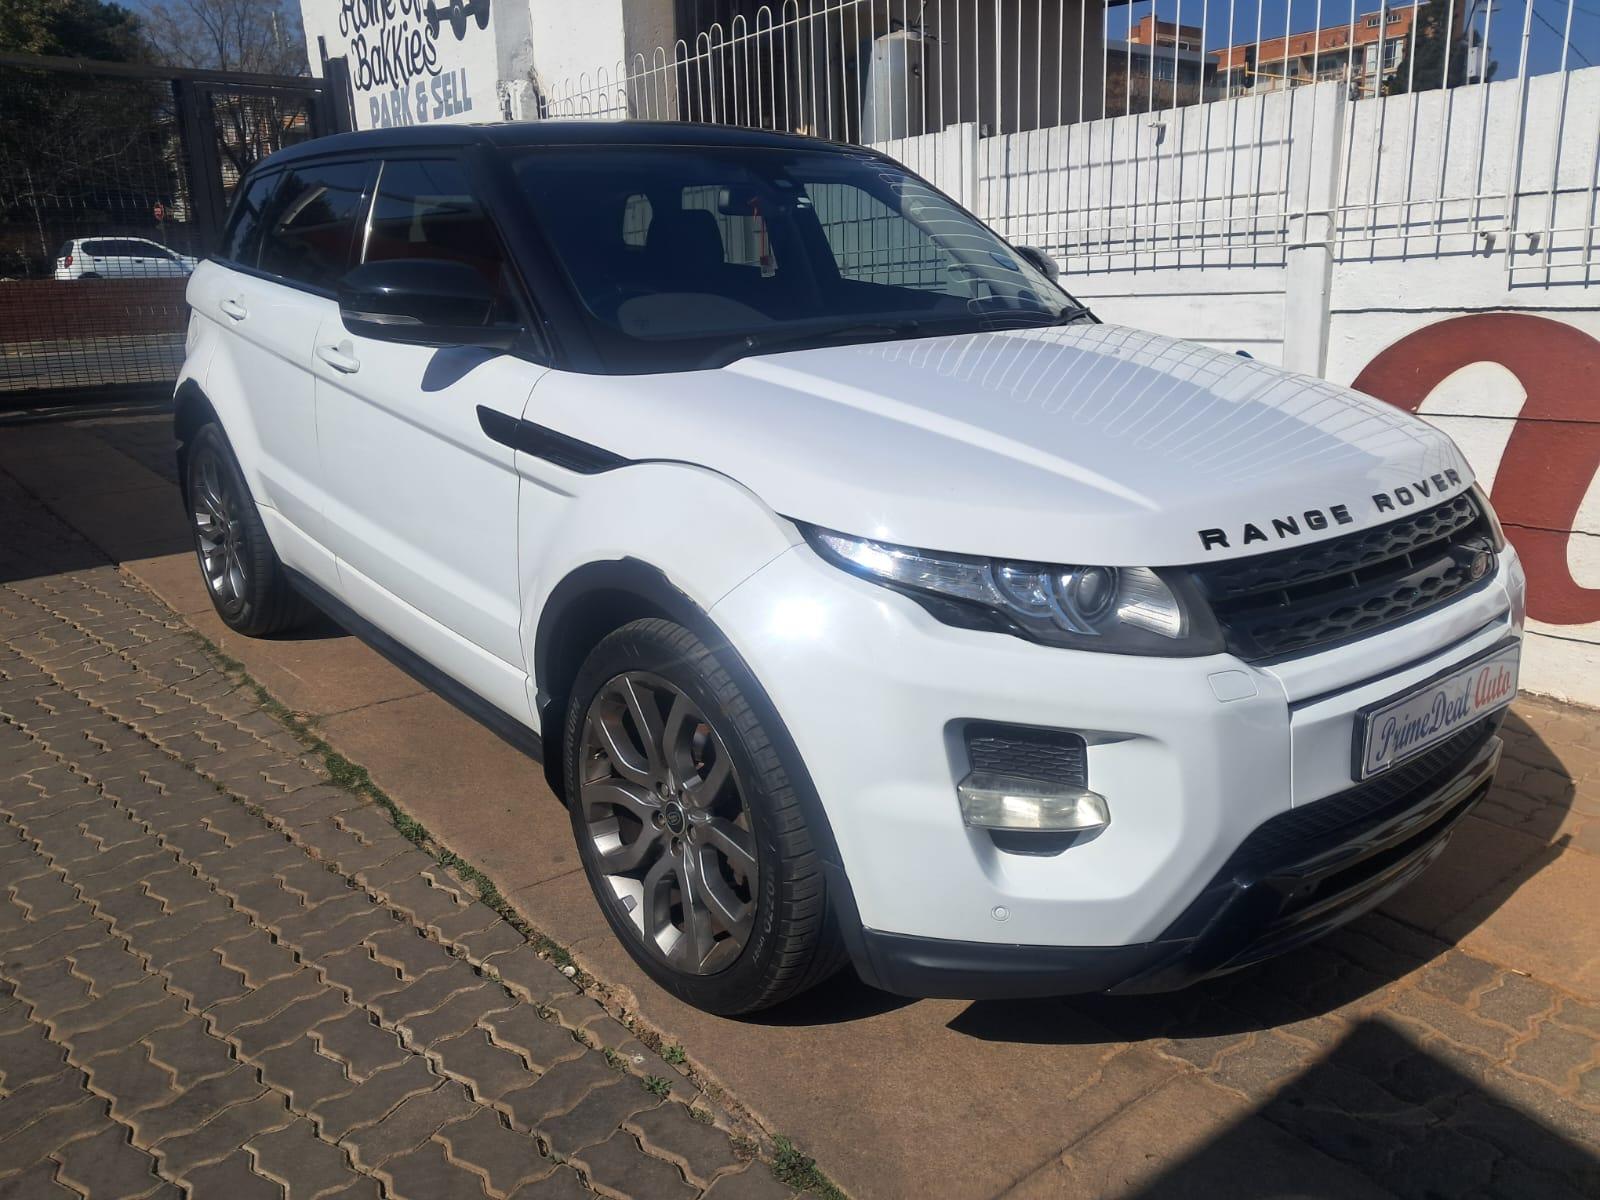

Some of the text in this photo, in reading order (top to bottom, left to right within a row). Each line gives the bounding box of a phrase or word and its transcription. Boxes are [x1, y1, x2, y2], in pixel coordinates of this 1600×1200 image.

[369, 67, 472, 128] PARK & SELL
[1197, 468, 1462, 550] RANGE ROVER
[1474, 664, 1511, 710] Auto
